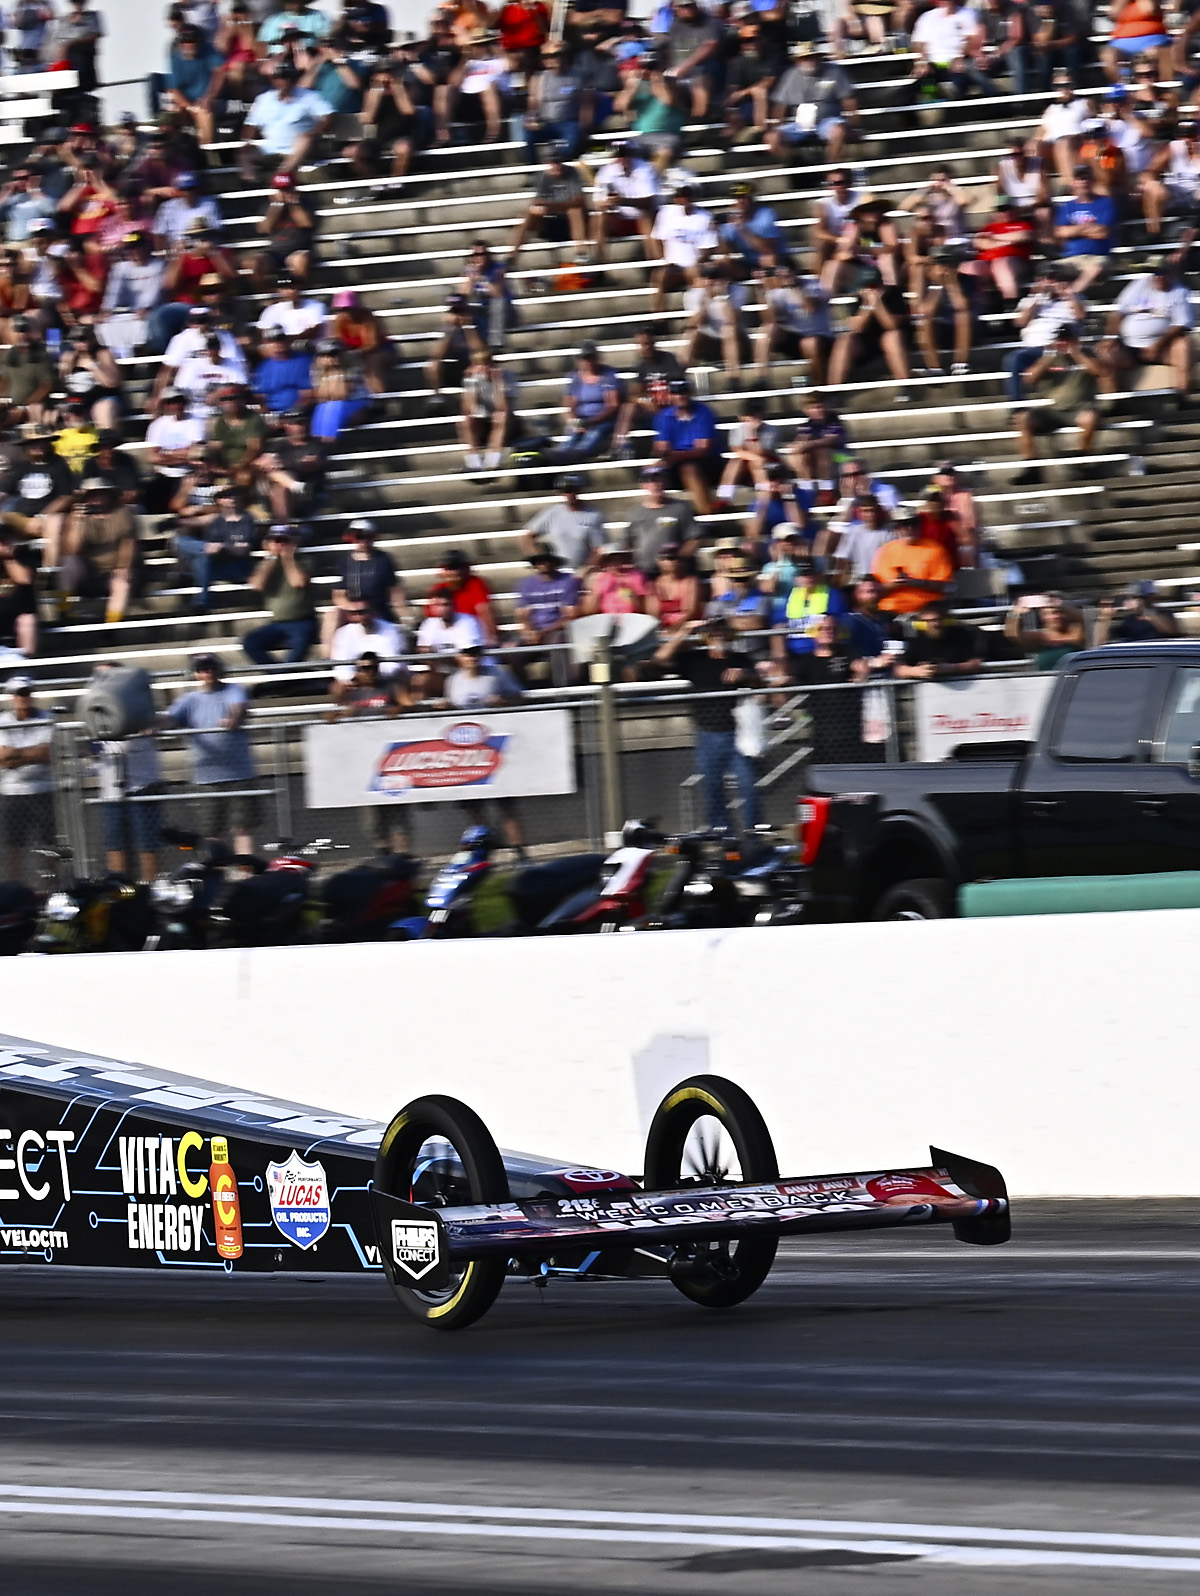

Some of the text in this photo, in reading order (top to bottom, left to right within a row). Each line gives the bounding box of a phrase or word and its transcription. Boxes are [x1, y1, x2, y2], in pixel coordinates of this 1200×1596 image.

[119, 1137, 176, 1195] VITA
[278, 1184, 323, 1206] LUCAS
[575, 1200, 745, 1222] WELCOME
[762, 1190, 854, 1208] BACK
[127, 1203, 205, 1252] ENERGY
[276, 1211, 328, 1224] OIL PRODUCTS
[0, 1229, 69, 1249] VELOCITI
[395, 1226, 435, 1248] PHILLIPS
[399, 1249, 434, 1262] CONNECT
